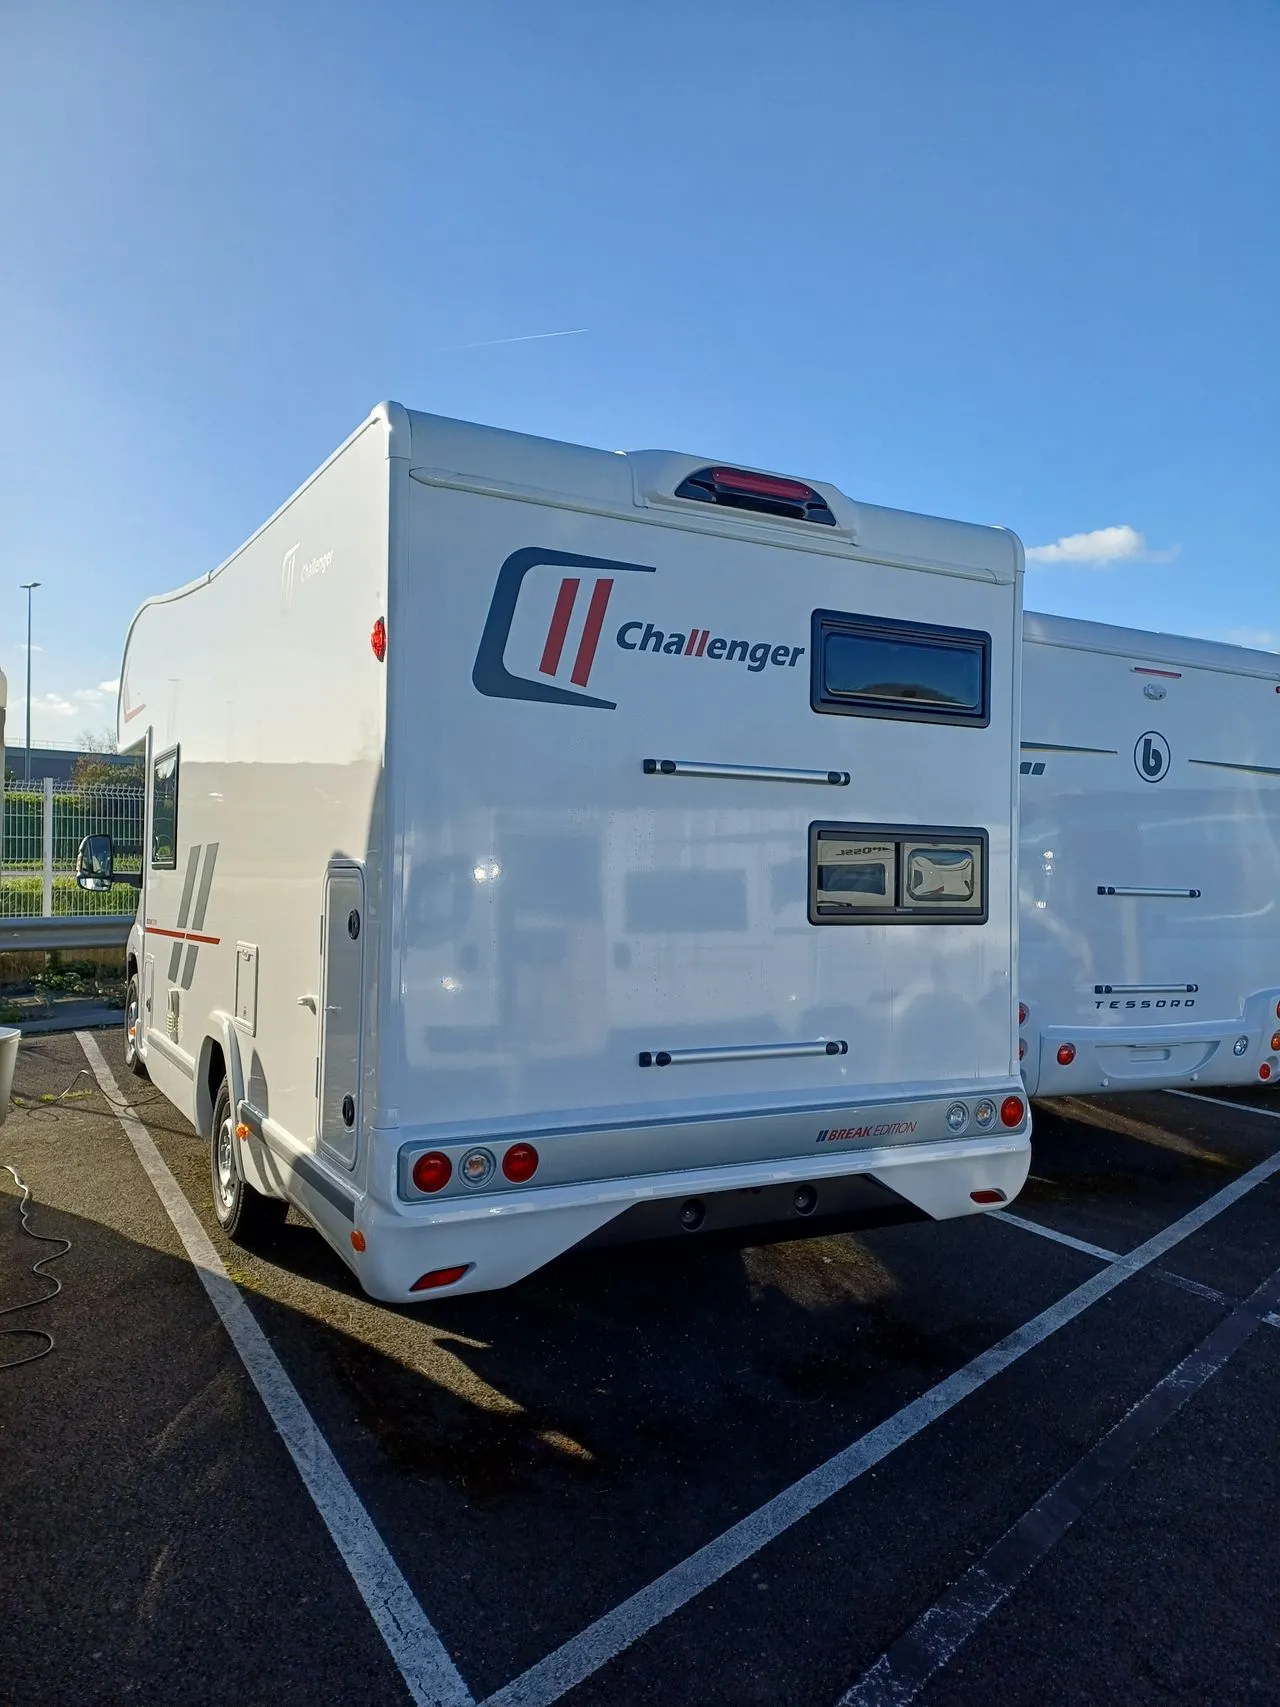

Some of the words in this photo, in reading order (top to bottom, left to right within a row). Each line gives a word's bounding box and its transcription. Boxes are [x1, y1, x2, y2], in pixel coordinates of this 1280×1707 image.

[616, 621, 805, 672] Challenger
[1094, 999, 1195, 1010] TESSORO
[828, 1125, 874, 1141] BREAK
[873, 1121, 918, 1137] EDITION
